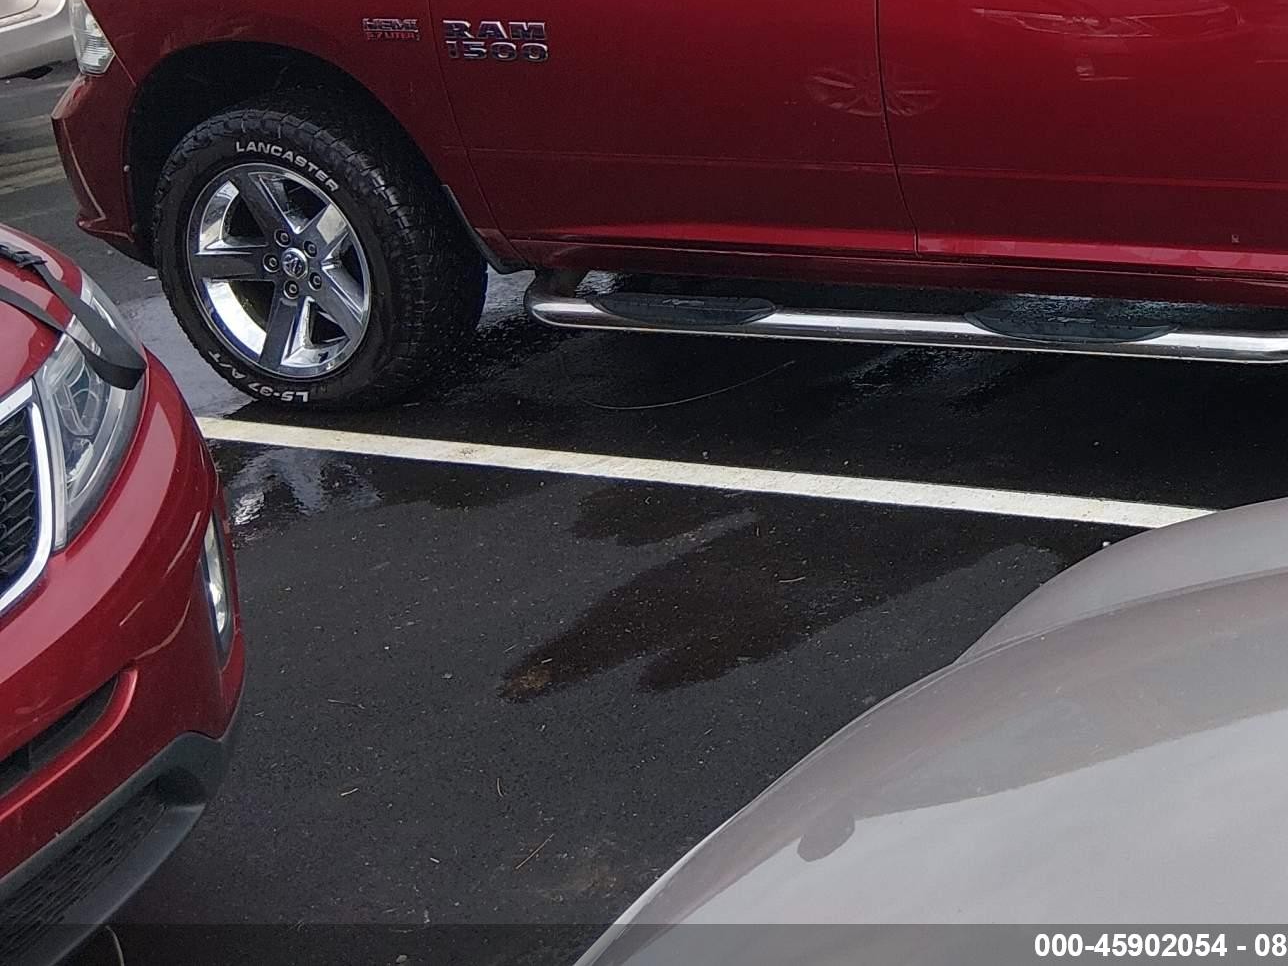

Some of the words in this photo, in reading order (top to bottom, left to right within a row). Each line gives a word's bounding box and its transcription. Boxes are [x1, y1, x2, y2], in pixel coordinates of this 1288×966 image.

[362, 18, 418, 32] HEMI
[443, 20, 547, 40] RAM
[445, 41, 549, 62] 1500
[235, 140, 340, 192] LANCASTER
[208, 350, 247, 379] A/T
[247, 382, 310, 403] LS-37
